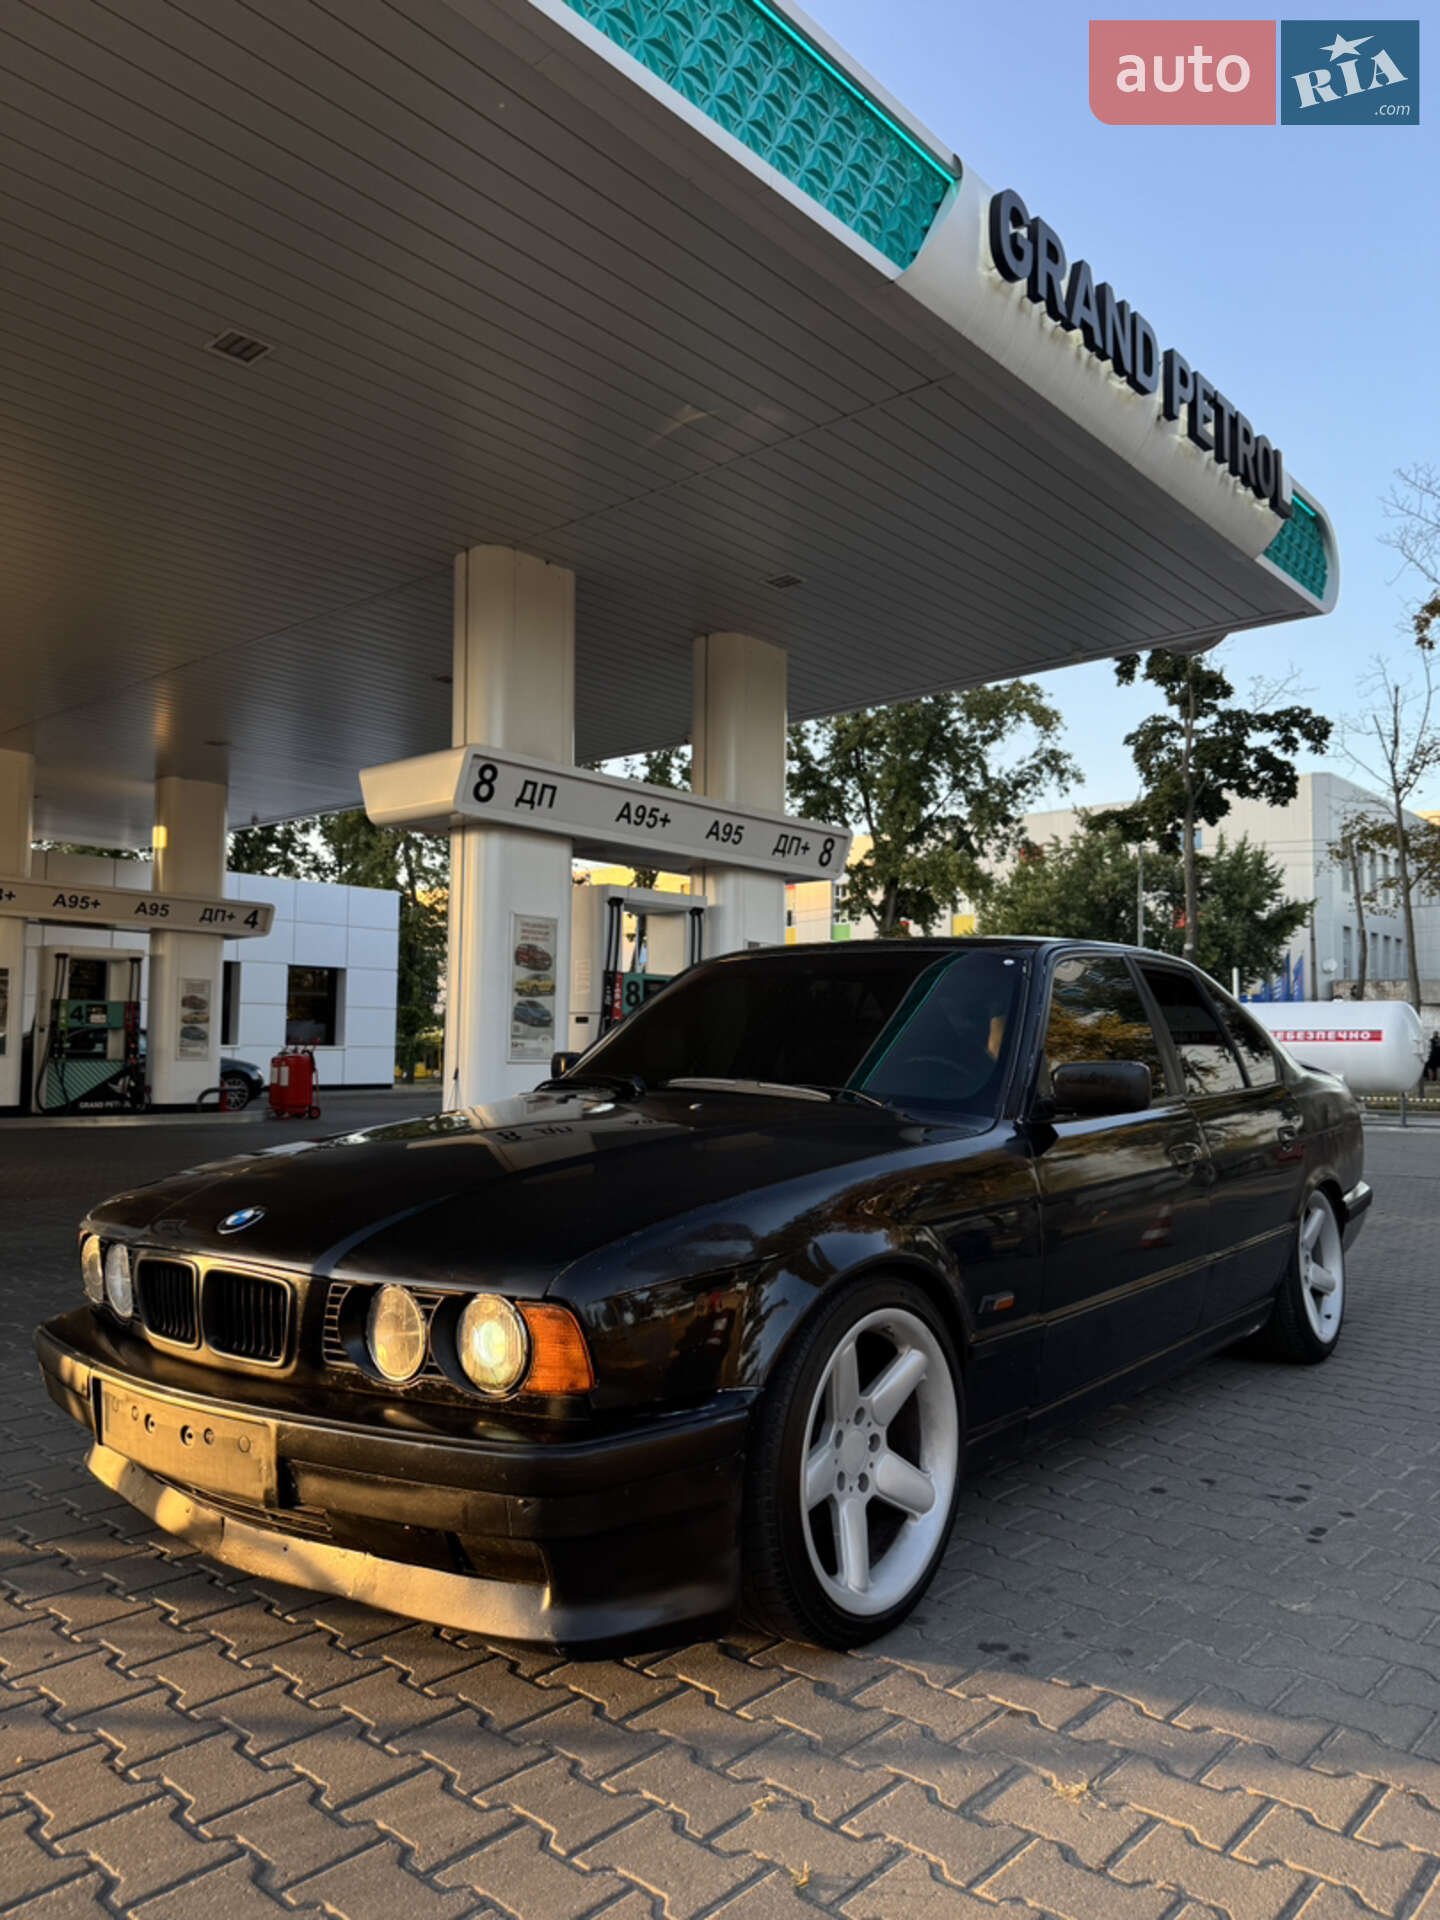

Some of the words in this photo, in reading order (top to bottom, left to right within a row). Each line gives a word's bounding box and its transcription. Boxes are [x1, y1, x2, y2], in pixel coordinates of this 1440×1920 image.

[989, 188, 1160, 396] GRAND
[1162, 348, 1292, 520] PETROL
[473, 763, 498, 803] 8
[514, 779, 558, 811] ДП
[615, 801, 671, 829] А95+
[705, 820, 745, 846] А95
[771, 833, 811, 859] ДП+
[818, 837, 835, 868] 8
[53, 893, 101, 910] А95+
[134, 901, 170, 918] А95
[199, 907, 236, 923] ДП+
[243, 909, 259, 929] 4
[626, 980, 640, 1008] 8
[70, 1004, 84, 1023] 4
[1271, 1030, 1371, 1041] ЕБЕЗПЕЧНО
